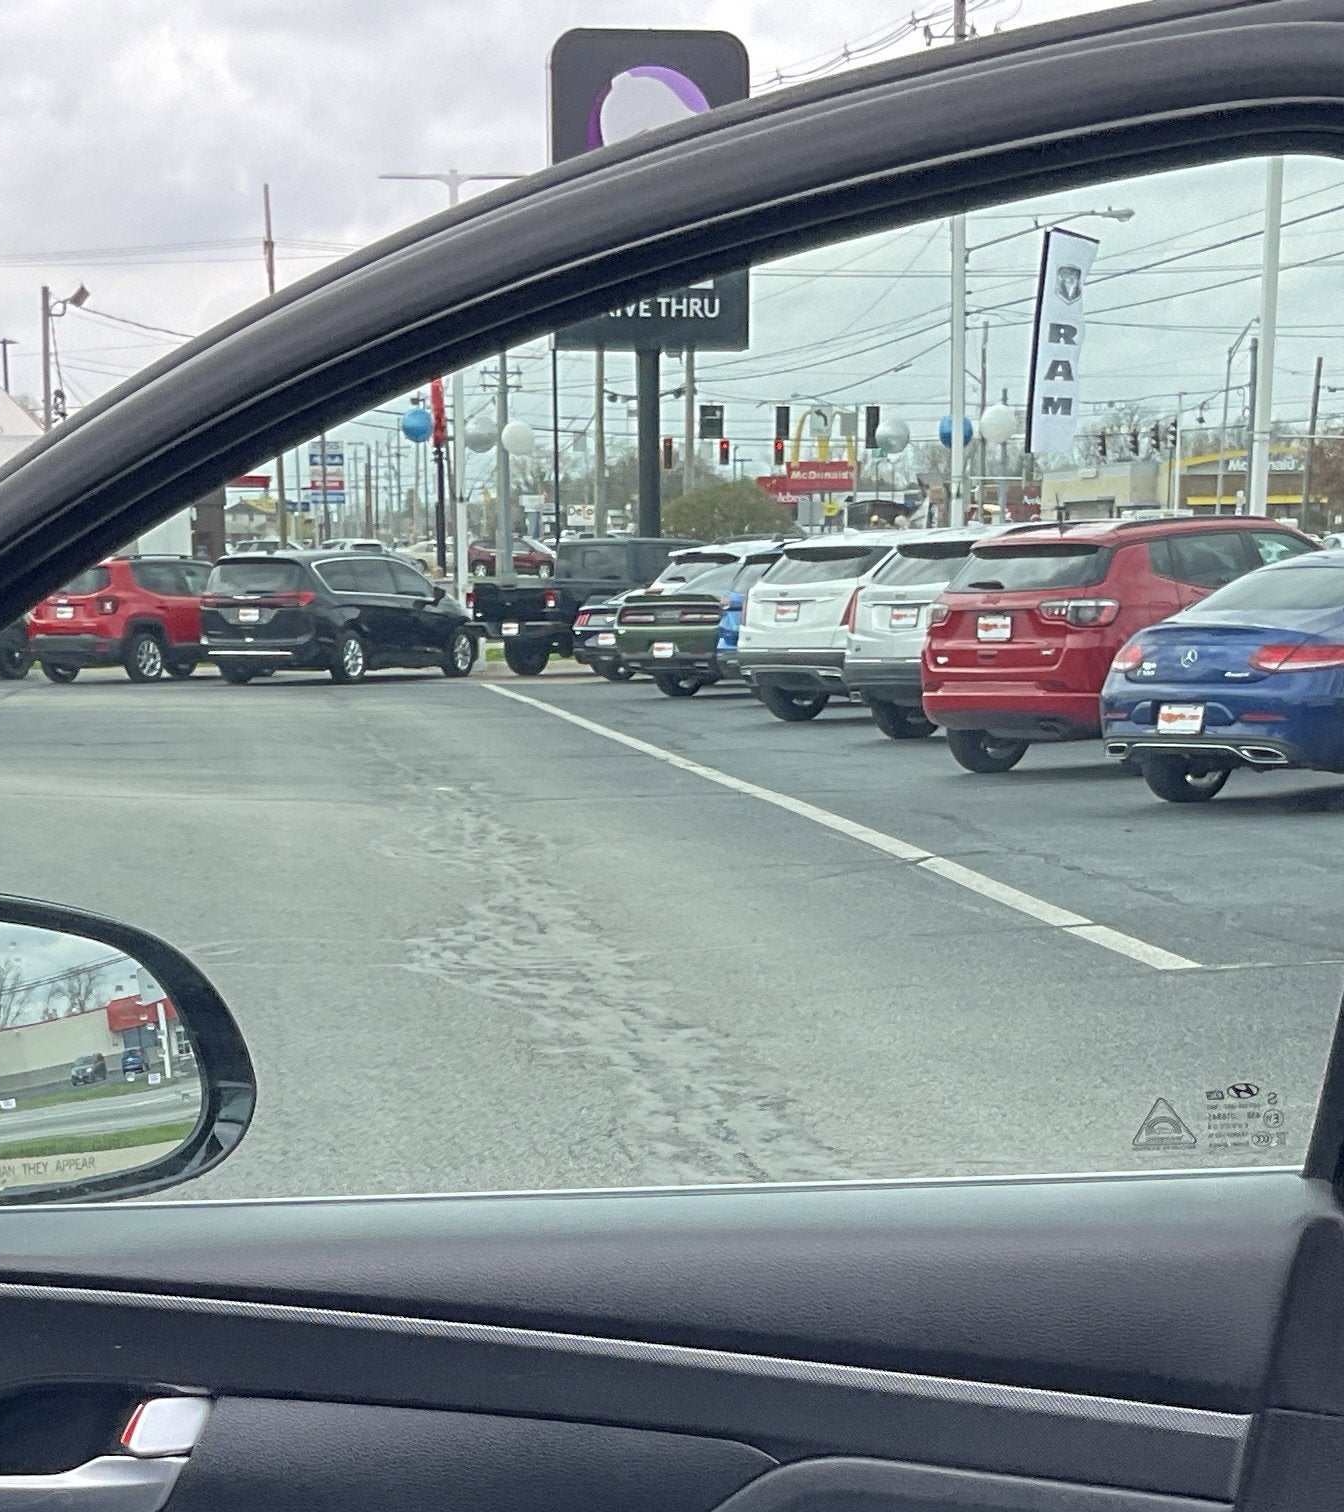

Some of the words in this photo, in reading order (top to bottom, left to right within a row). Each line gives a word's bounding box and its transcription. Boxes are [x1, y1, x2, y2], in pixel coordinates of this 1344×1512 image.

[657, 297, 720, 318] THRU
[1041, 323, 1078, 416] RAM
[22, 1163, 49, 1176] THEY
[56, 1157, 96, 1172] APPEAR
